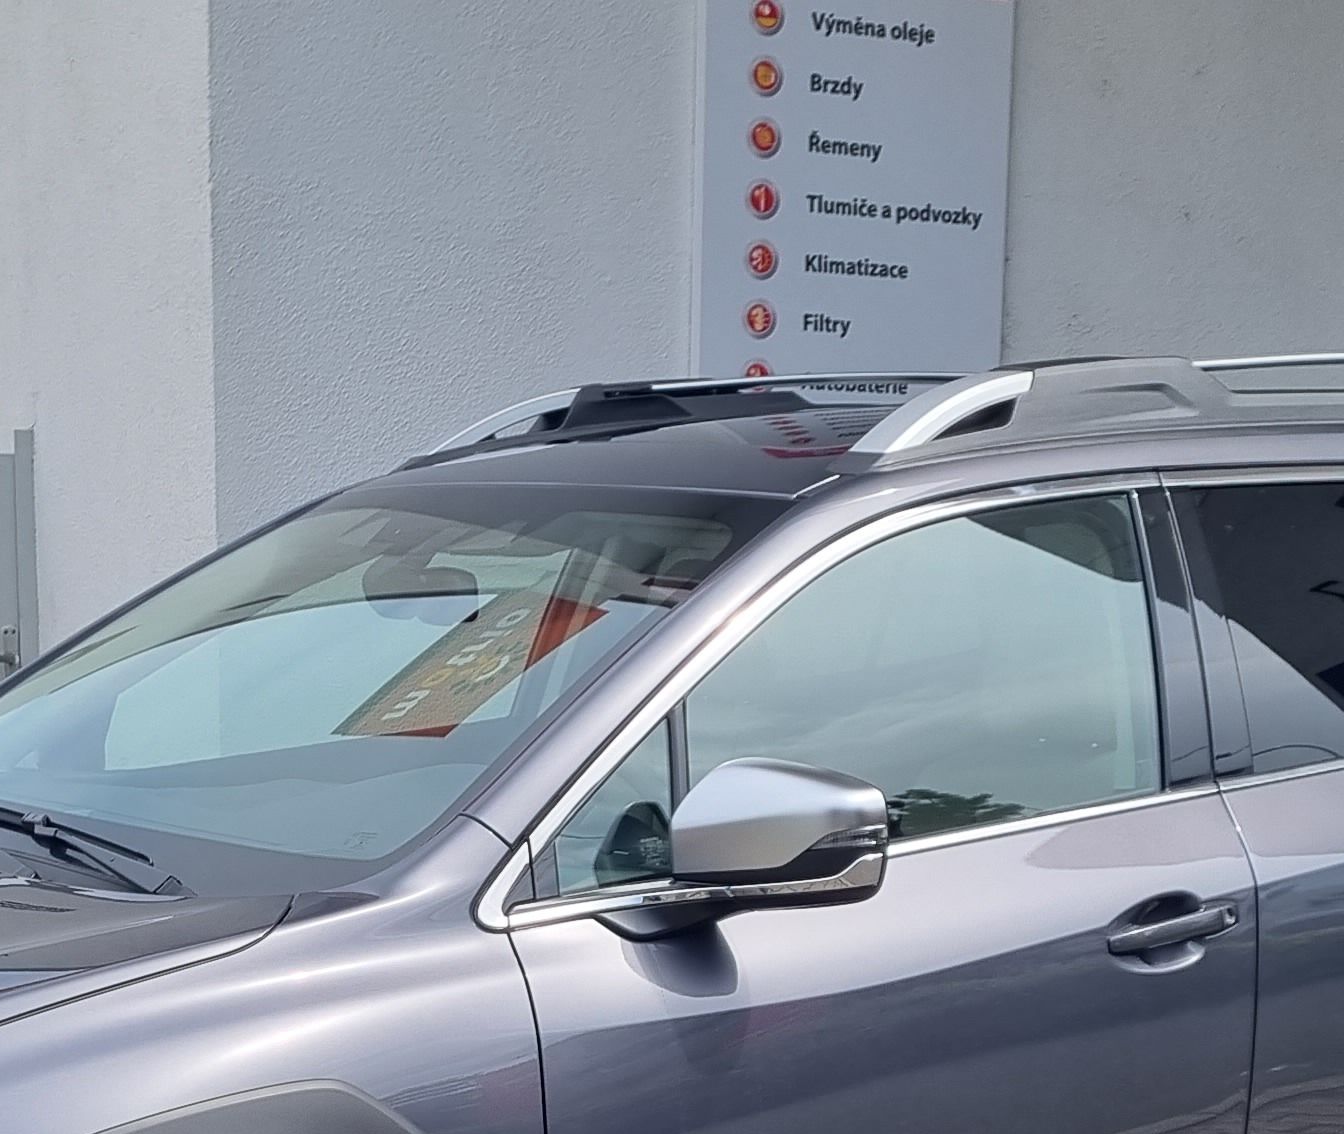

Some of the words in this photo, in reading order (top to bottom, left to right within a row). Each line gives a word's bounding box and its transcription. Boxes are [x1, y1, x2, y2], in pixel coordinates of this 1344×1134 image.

[812, 11, 886, 37] Výměna
[890, 21, 935, 47] oleje
[810, 73, 864, 101] Brzdy
[808, 130, 882, 163] Řemeny
[806, 194, 877, 218] Tlumiče
[881, 205, 892, 218] a
[896, 203, 983, 230] podvozky
[805, 254, 909, 279] Klimatizace
[803, 313, 851, 338] Filtry
